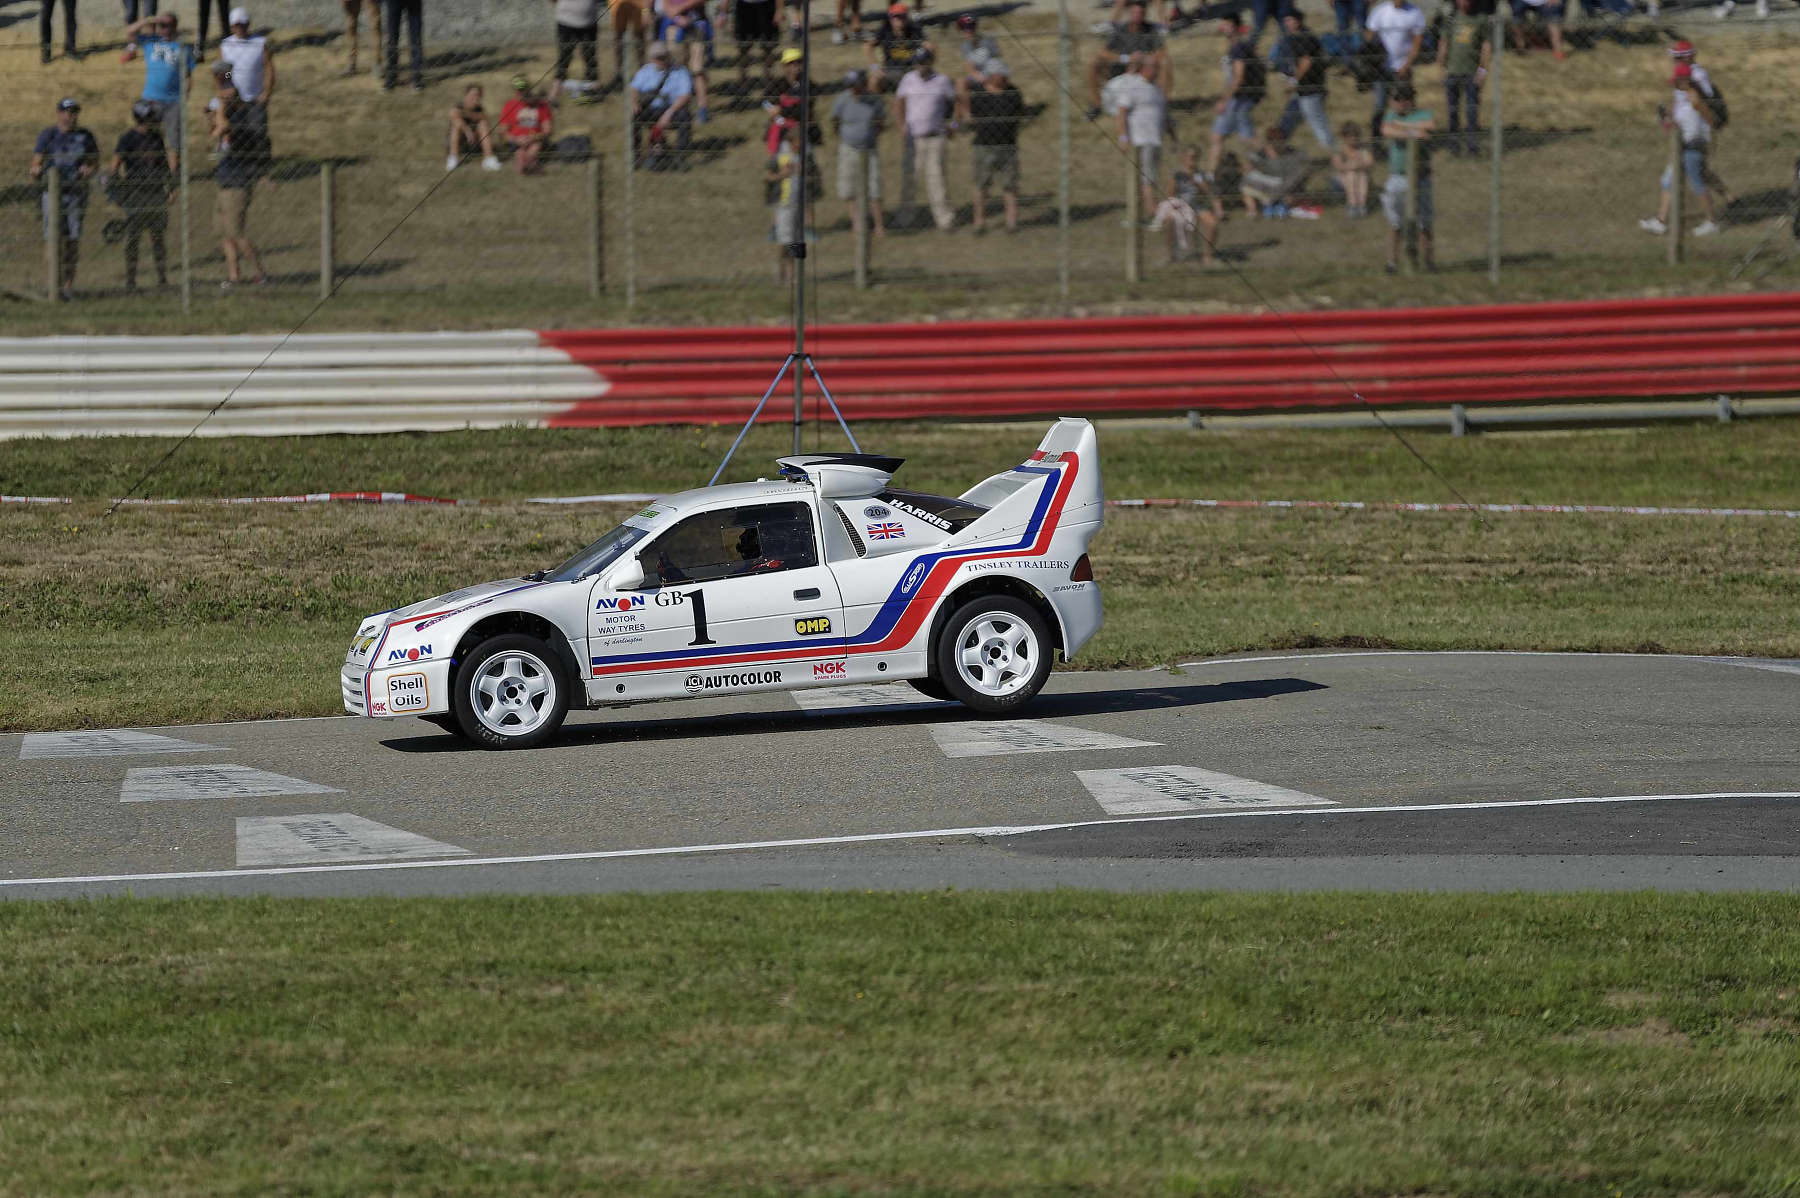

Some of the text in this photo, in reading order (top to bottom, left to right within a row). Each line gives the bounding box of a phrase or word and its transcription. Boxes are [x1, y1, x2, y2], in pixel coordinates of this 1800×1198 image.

[889, 499, 952, 530] HARRIS
[966, 560, 1070, 572] TINSLEY TRAILERS
[595, 595, 646, 611] AVON
[654, 590, 684, 607] GB
[605, 614, 637, 624] MOTOR
[683, 588, 717, 646] 1
[598, 623, 646, 635] WAY TYRES
[796, 618, 829, 633] OMP
[388, 643, 433, 661] AVON
[813, 661, 846, 675] NGK
[390, 677, 423, 691] Shell
[704, 670, 782, 689] AUTOCOLOR
[395, 694, 422, 706] Oils
